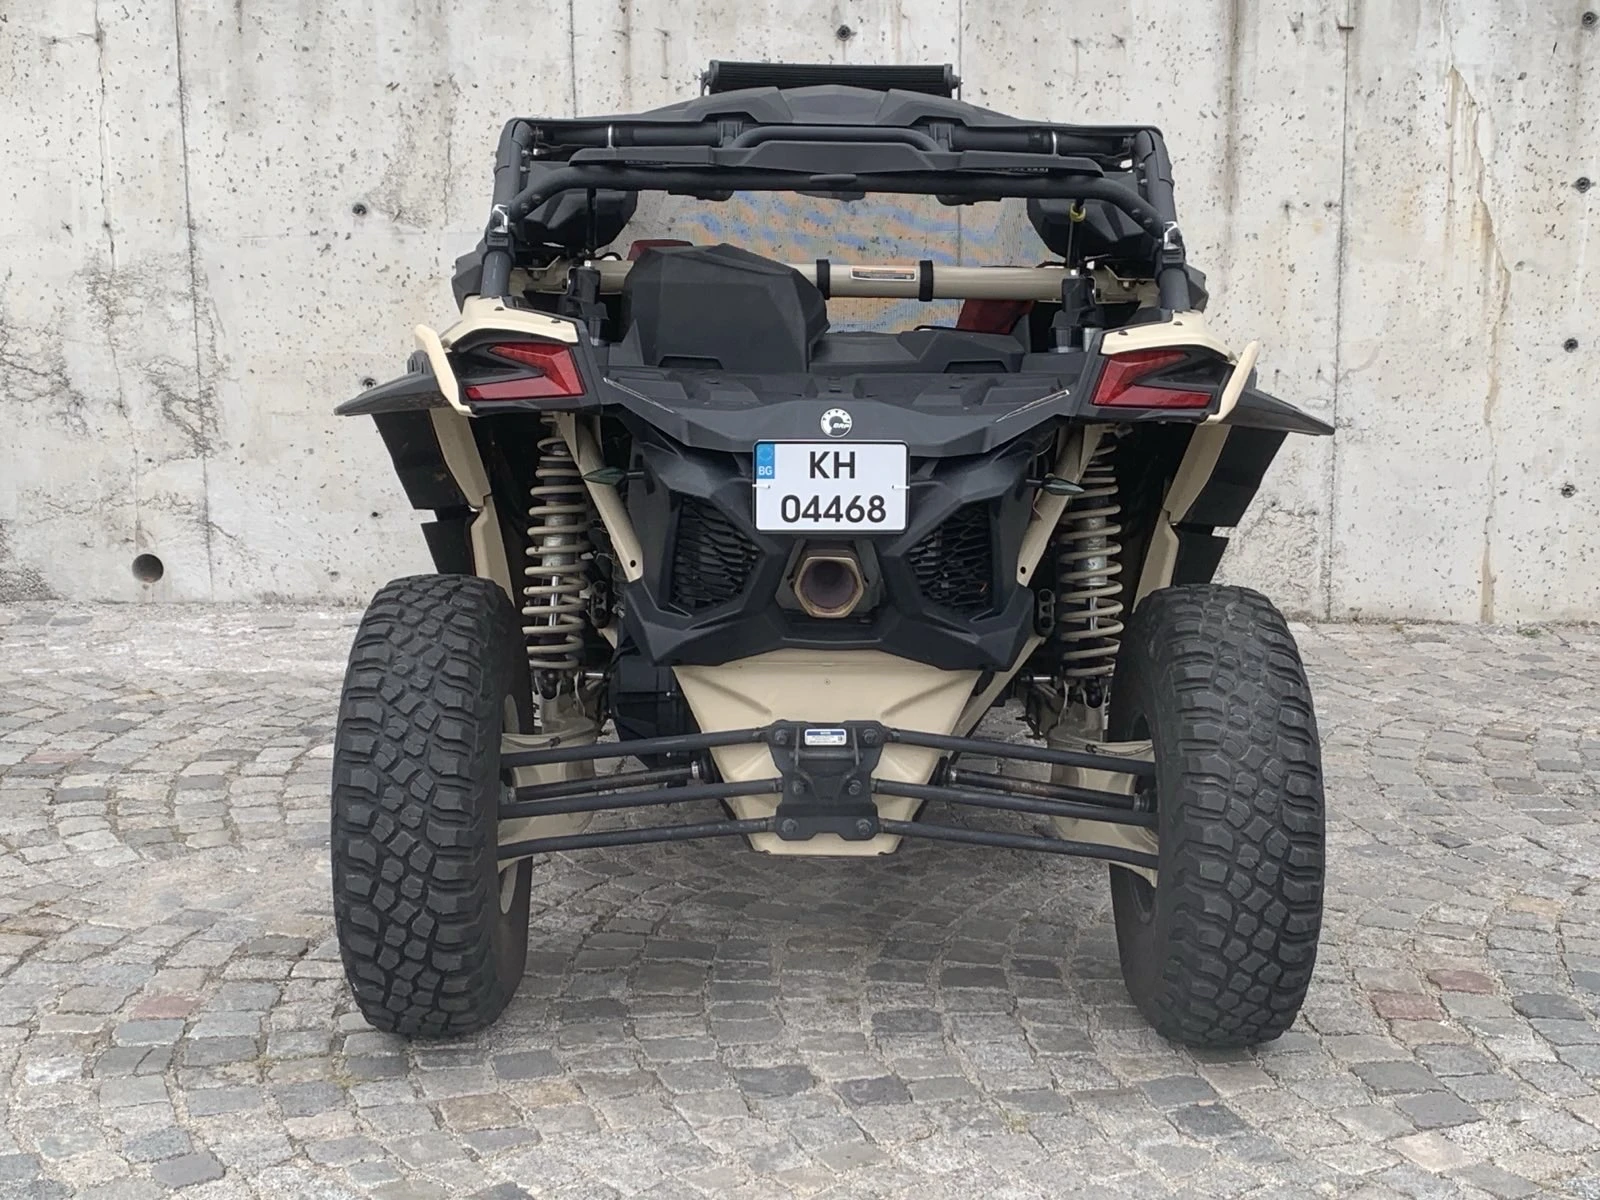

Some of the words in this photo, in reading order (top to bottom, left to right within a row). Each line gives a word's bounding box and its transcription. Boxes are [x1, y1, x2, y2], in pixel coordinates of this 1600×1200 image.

[758, 466, 773, 476] BG
[809, 451, 856, 479] KH
[780, 494, 887, 523] 04468
